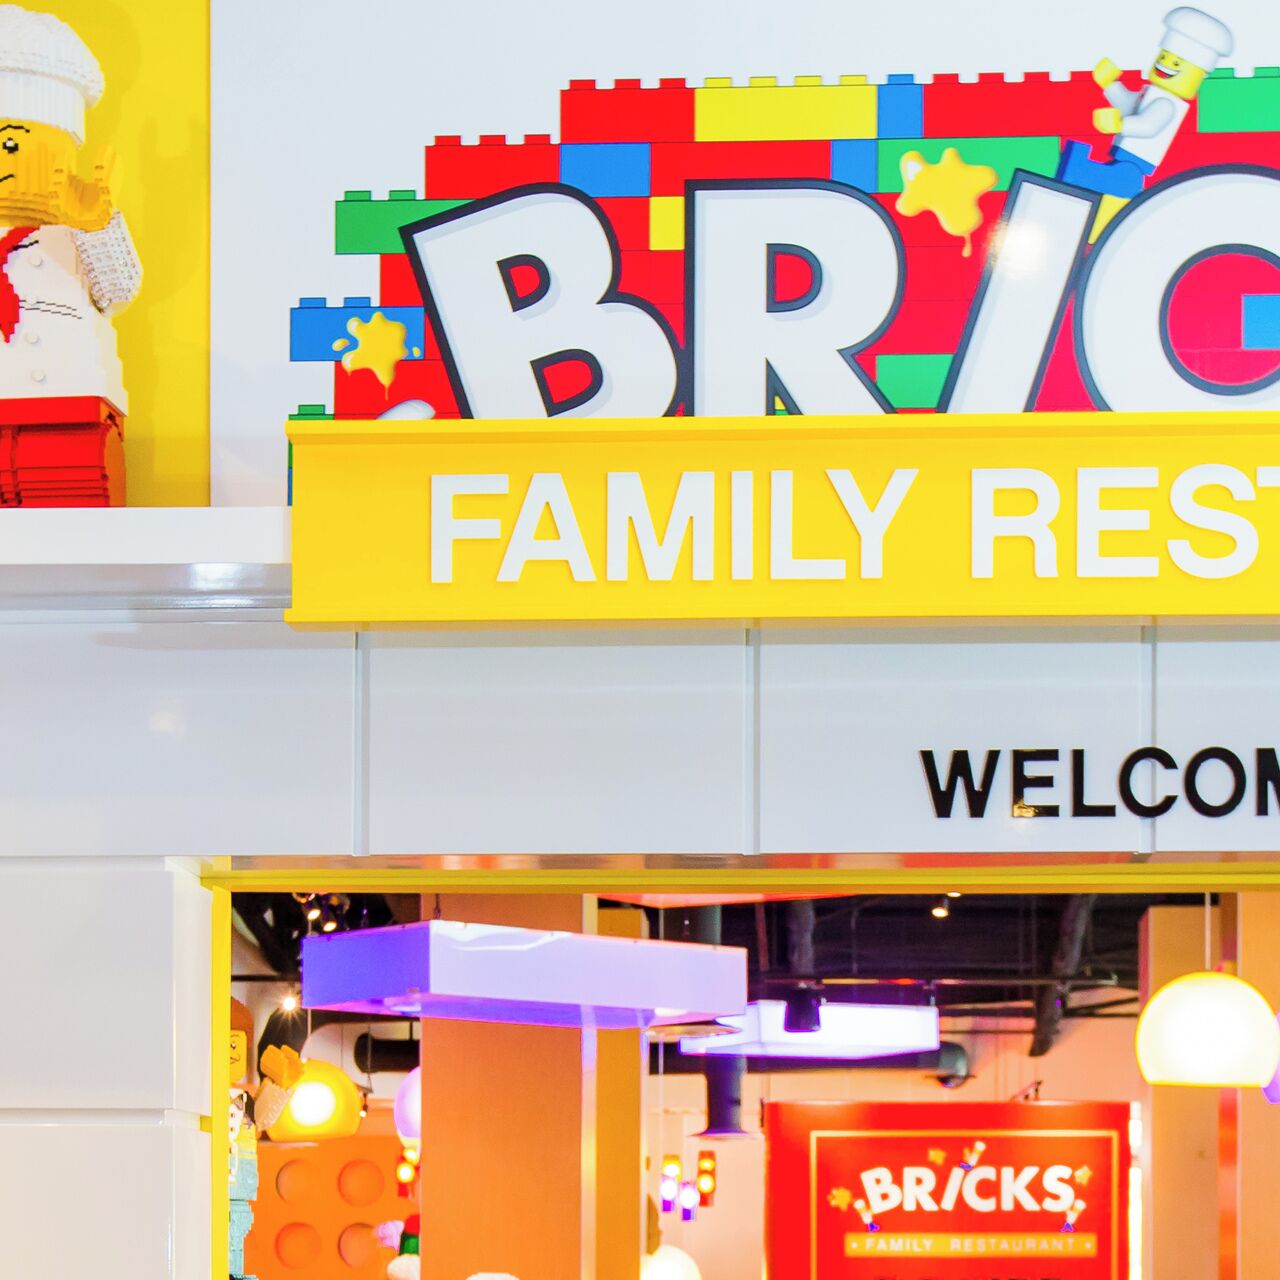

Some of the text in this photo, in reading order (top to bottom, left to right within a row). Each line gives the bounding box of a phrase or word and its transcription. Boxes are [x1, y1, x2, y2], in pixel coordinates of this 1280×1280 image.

[427, 469, 920, 584] FAMILY
[860, 1165, 1076, 1214] BRICKS
[865, 1238, 1075, 1252] FAMILY RESTAURANT
